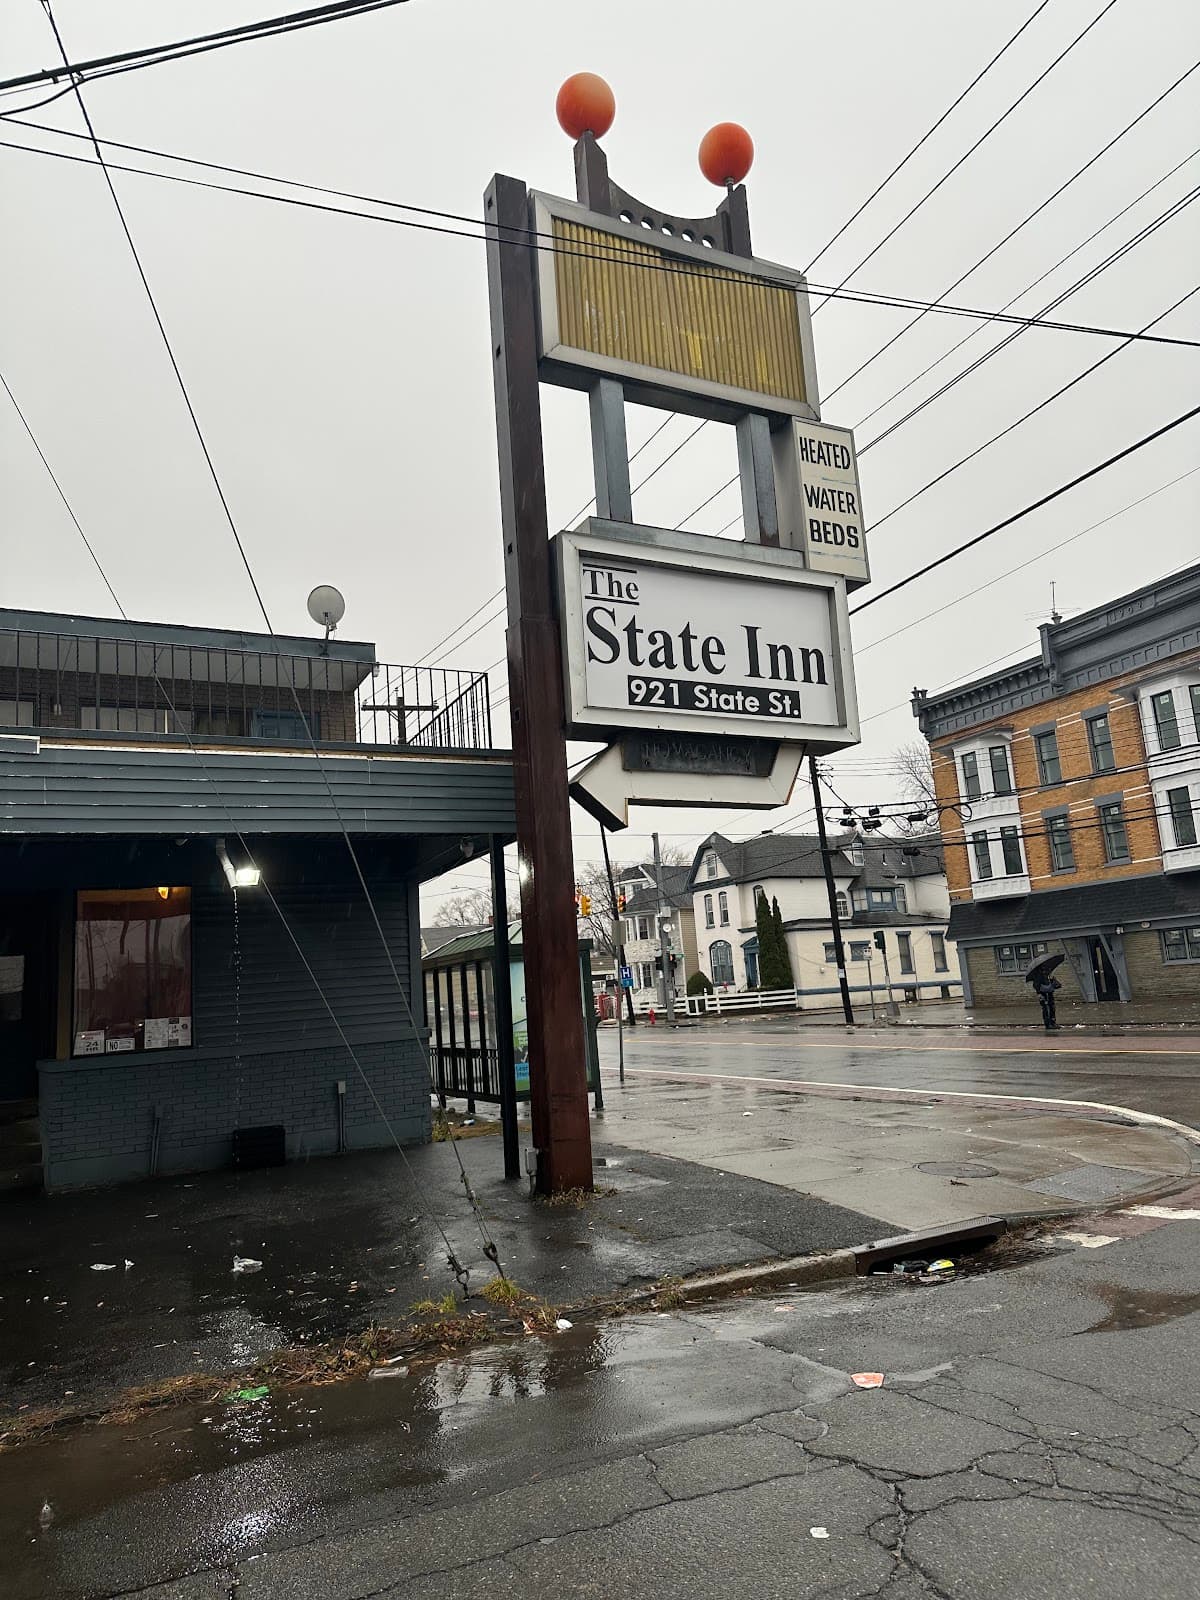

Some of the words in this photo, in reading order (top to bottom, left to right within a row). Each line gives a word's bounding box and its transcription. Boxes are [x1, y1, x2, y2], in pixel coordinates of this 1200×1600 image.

[799, 436, 850, 470] HEATED
[803, 483, 857, 515] WATER
[809, 518, 859, 549] BEDS
[582, 568, 639, 600] The
[585, 605, 727, 675] State
[740, 624, 829, 686] Inn
[629, 679, 681, 706] 921
[693, 684, 760, 713] State
[768, 691, 799, 716] St.
[109, 1041, 119, 1051] NO
